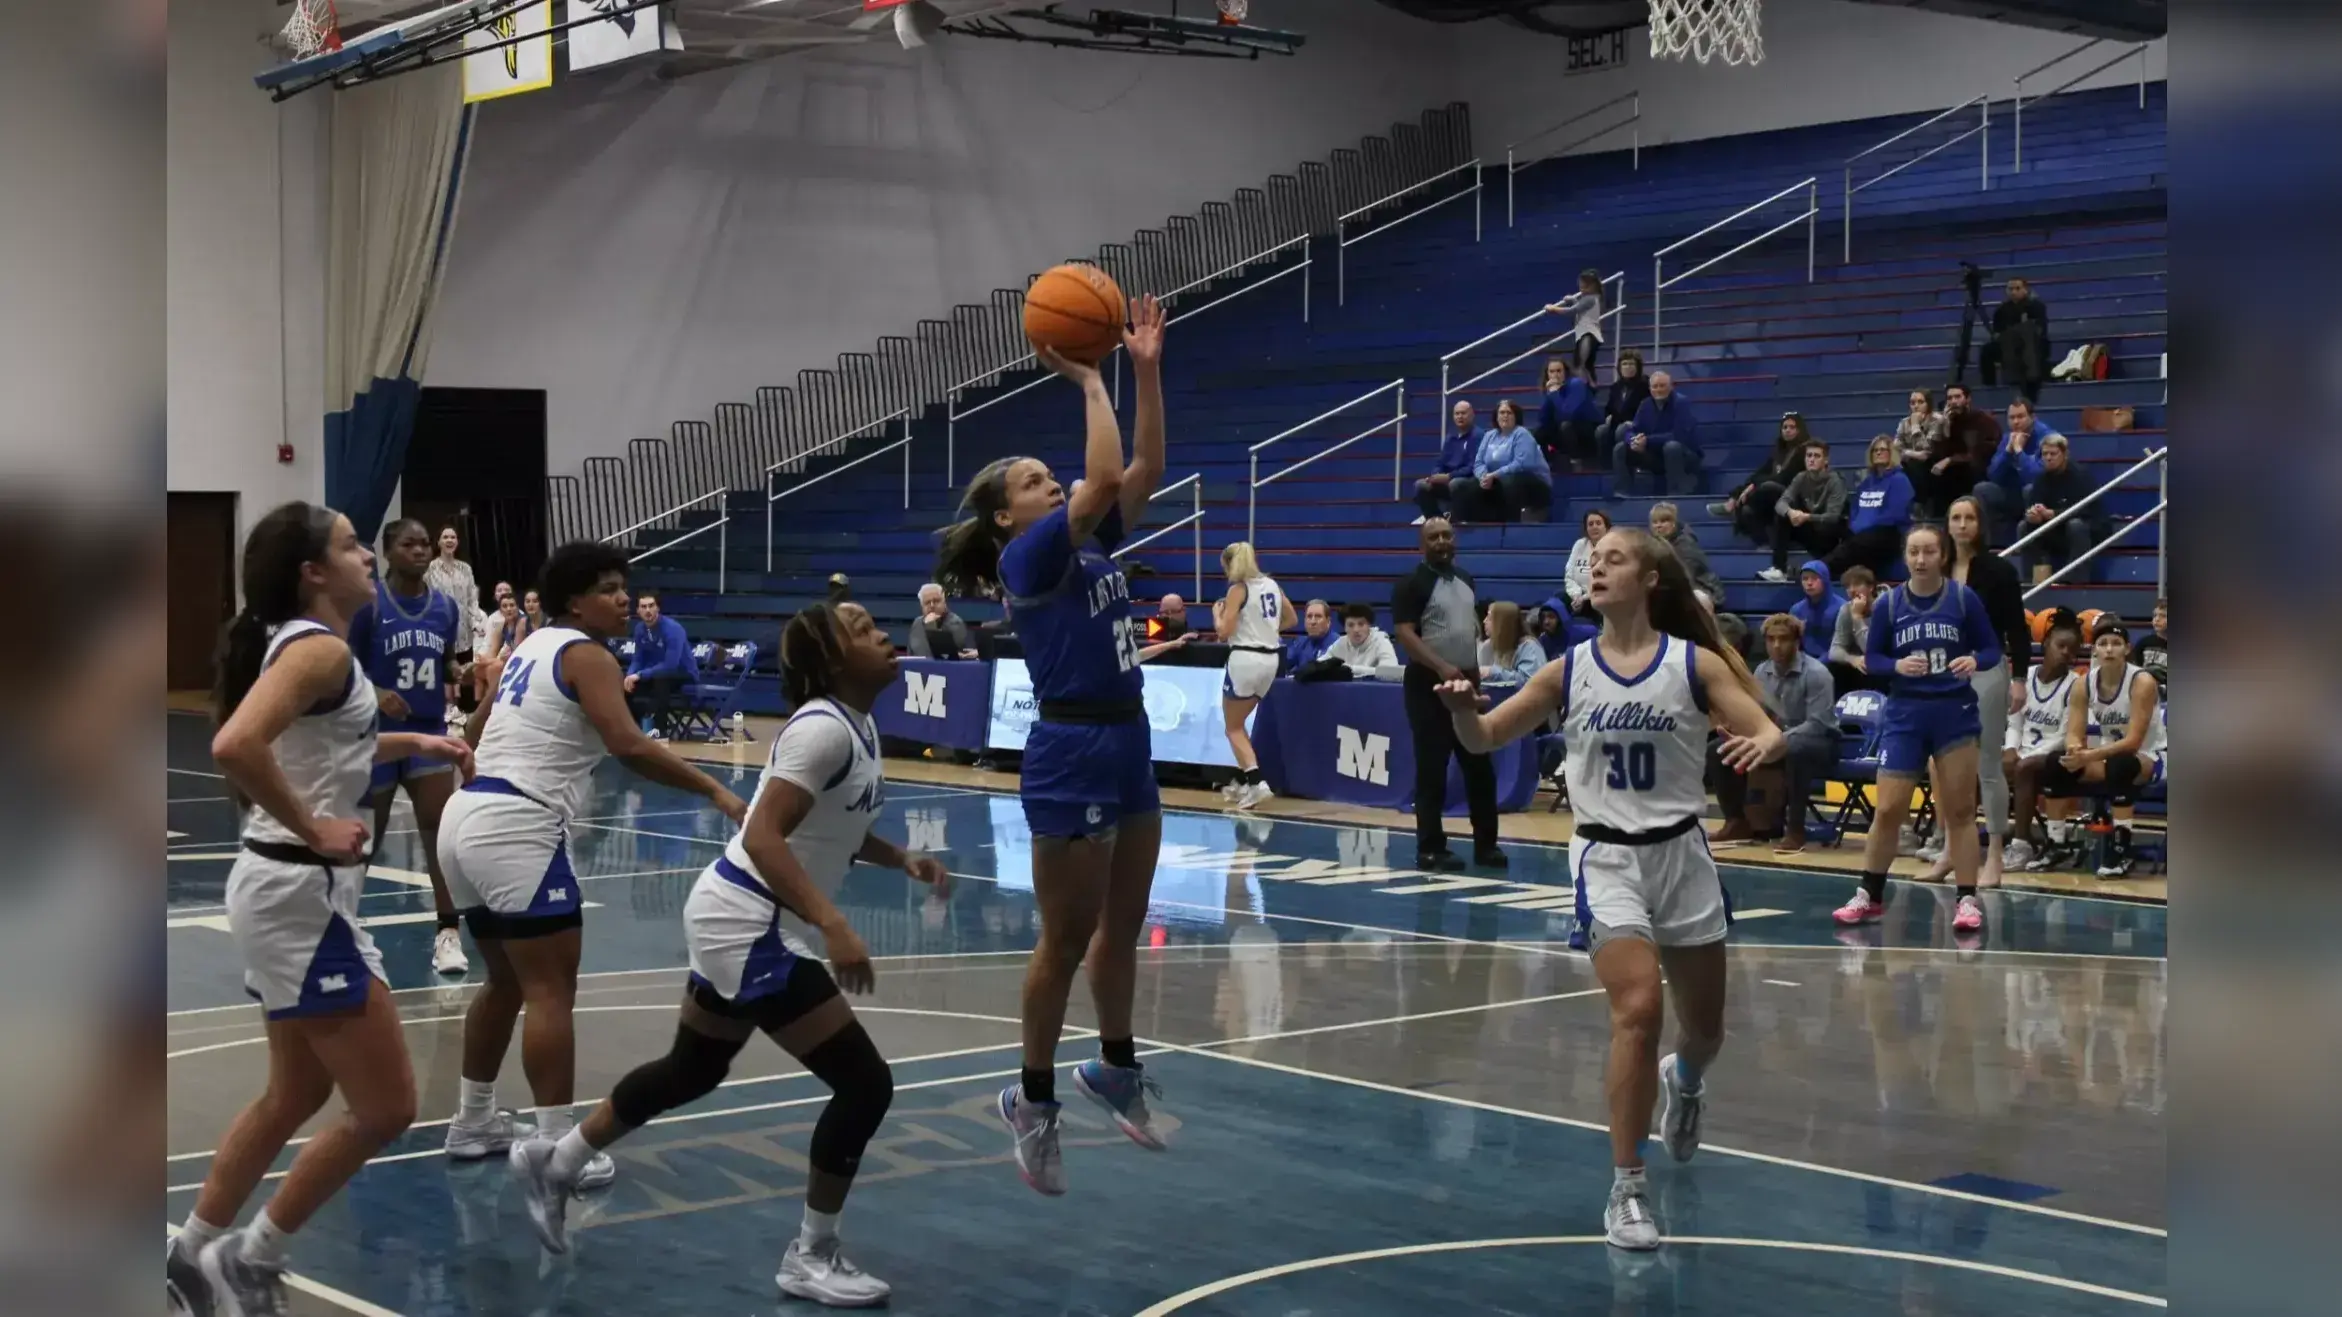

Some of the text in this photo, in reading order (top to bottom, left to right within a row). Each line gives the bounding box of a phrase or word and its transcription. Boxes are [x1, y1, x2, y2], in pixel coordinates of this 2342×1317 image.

[1260, 592, 1277, 618] 13
[384, 629, 445, 656] LADY BLUES
[1895, 622, 1960, 648] LADY BLUES
[396, 657, 437, 690] 34
[494, 656, 537, 708] 24
[903, 669, 947, 719] M
[1582, 701, 1678, 733] Millikin
[2029, 727, 2043, 746] 7
[1336, 723, 1391, 787] M
[1601, 741, 1657, 792] 30
